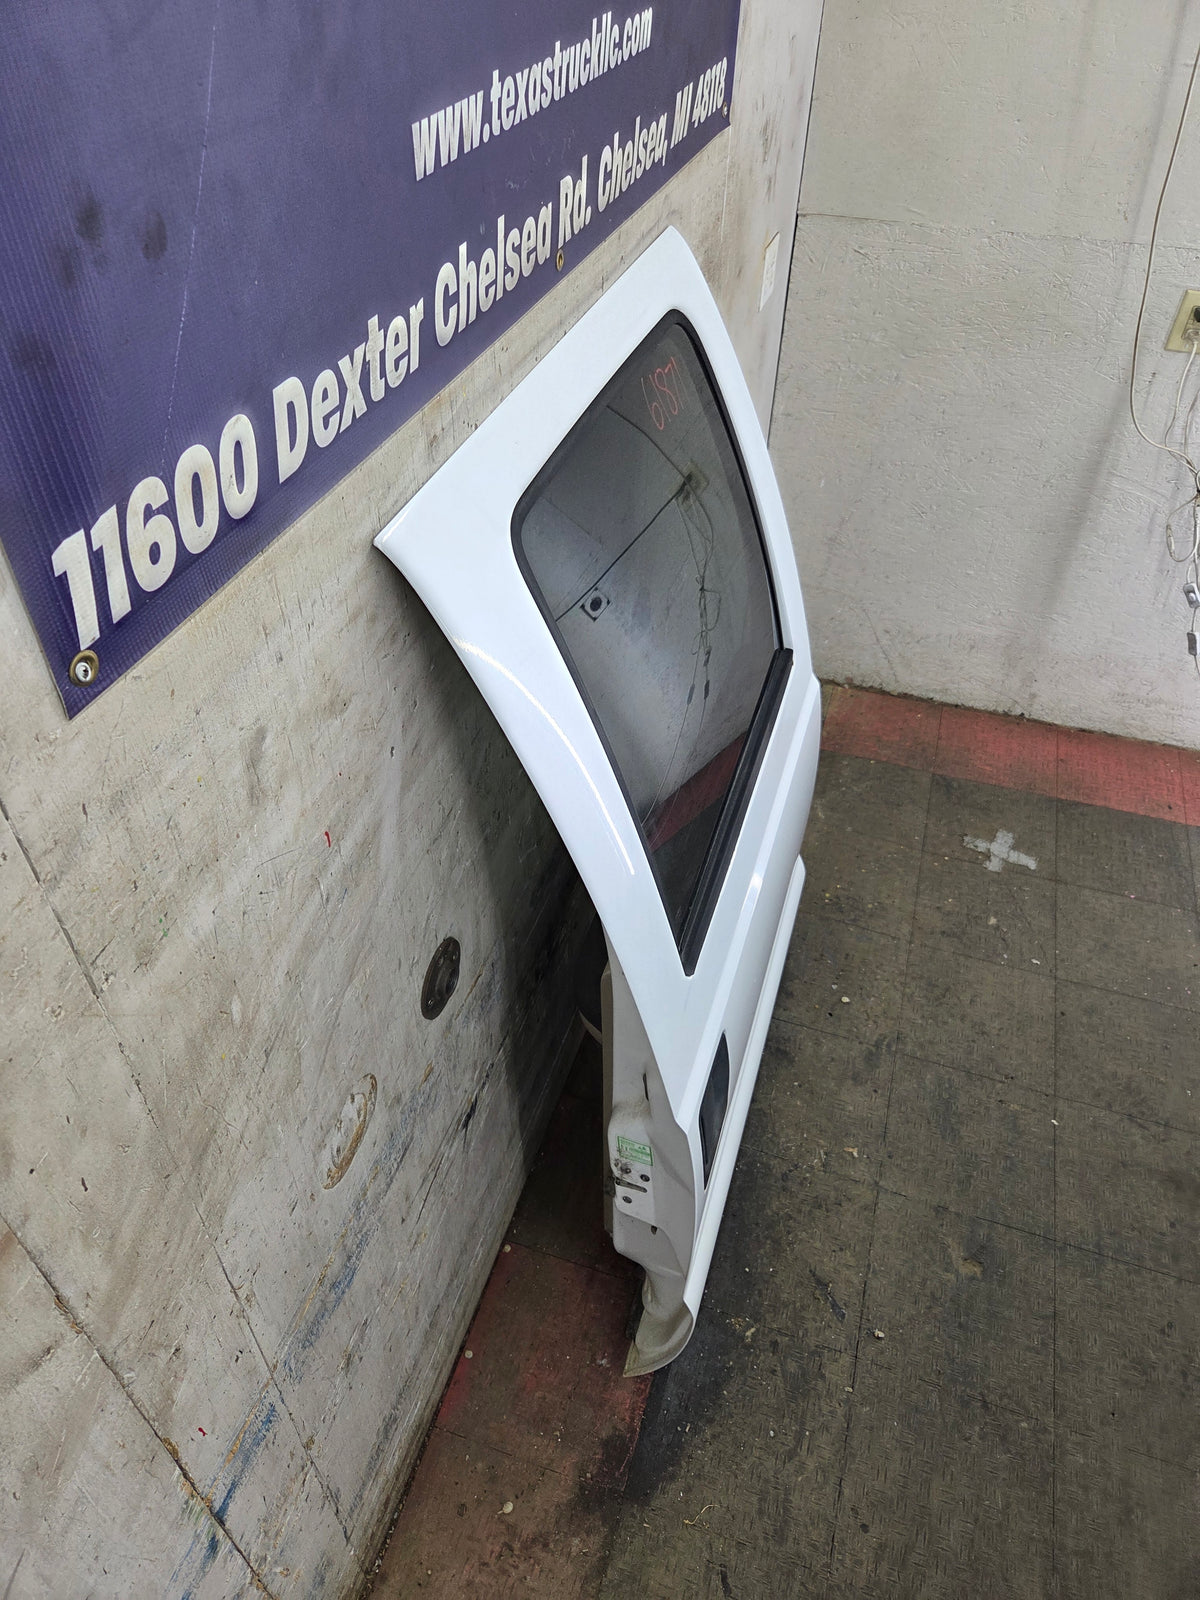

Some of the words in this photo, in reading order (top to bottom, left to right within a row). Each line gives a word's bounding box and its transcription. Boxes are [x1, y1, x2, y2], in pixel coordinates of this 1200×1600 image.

[411, 7, 652, 181] www.texastruckllc.com
[51, 413, 258, 651] 11600
[272, 297, 424, 484] Dexter
[435, 202, 552, 347] Chelsea
[558, 154, 592, 249] Rd.
[598, 112, 668, 213] Chelsea,
[670, 82, 693, 149] MI
[692, 57, 728, 128] 48118
